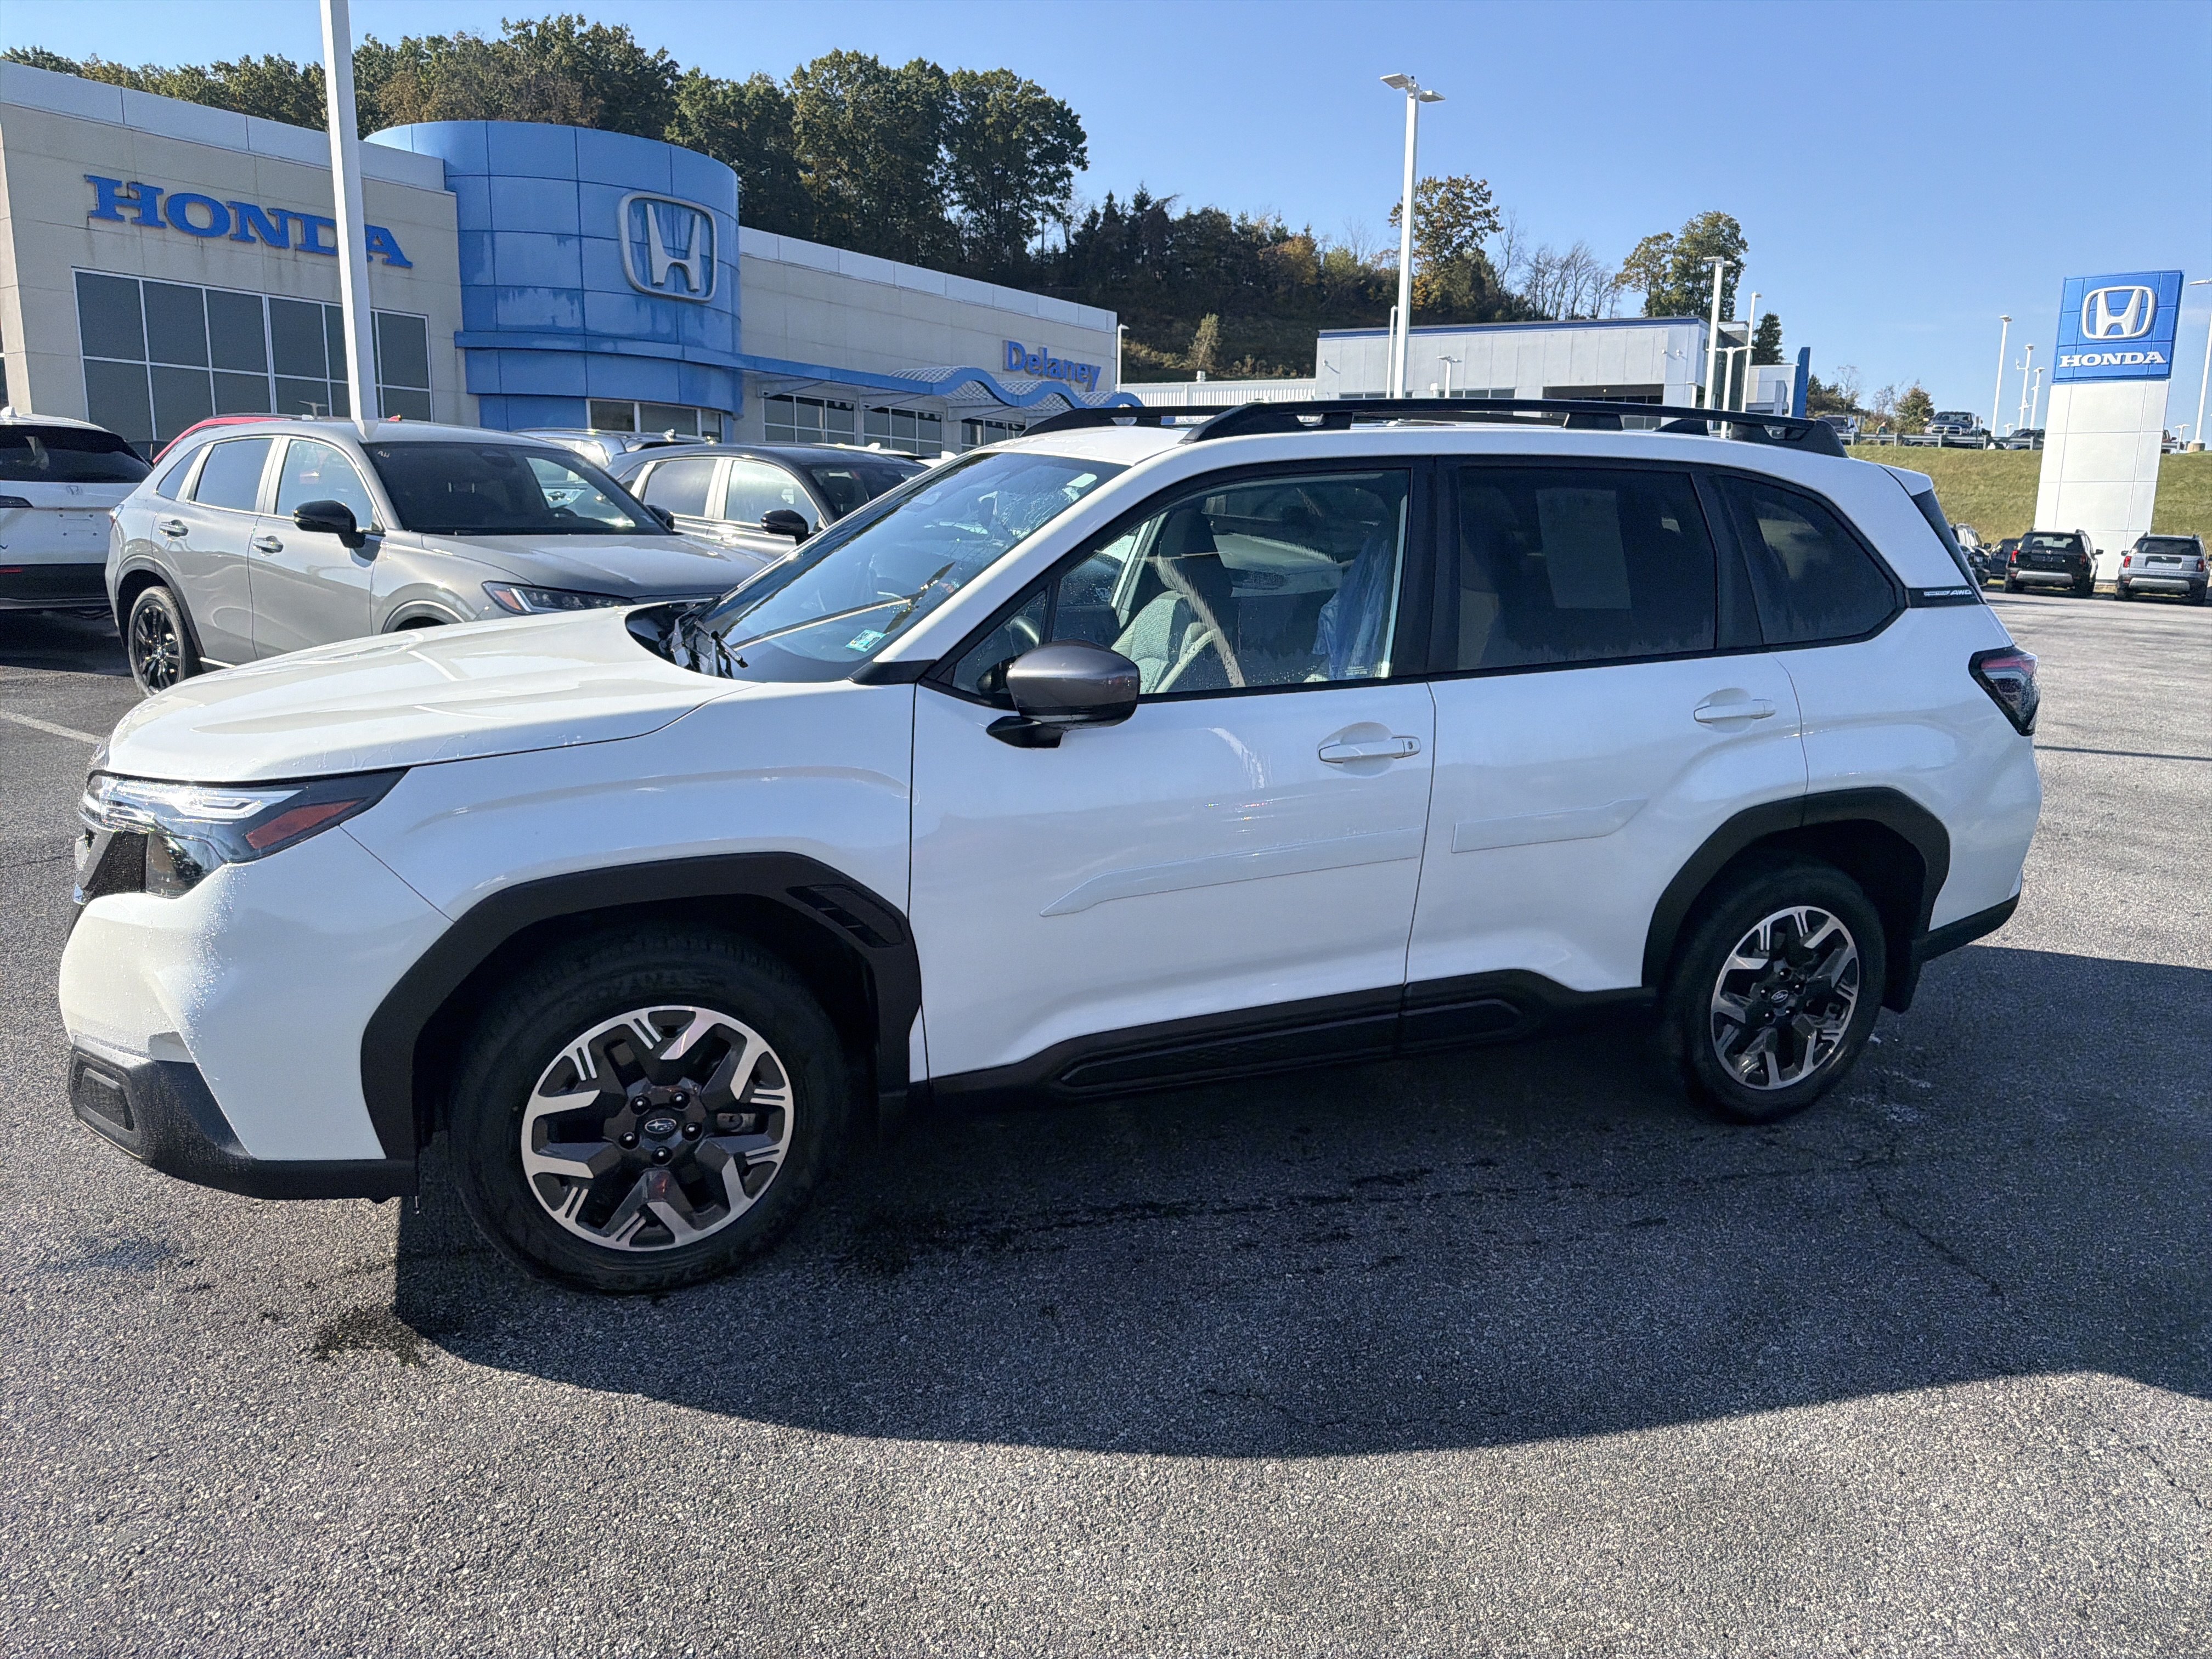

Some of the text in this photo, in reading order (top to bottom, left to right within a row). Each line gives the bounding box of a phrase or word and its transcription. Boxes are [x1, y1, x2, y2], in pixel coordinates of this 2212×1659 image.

[84, 175, 413, 268] HONDA
[1003, 340, 1101, 392] Delaney
[2059, 351, 2166, 368] HONDA
